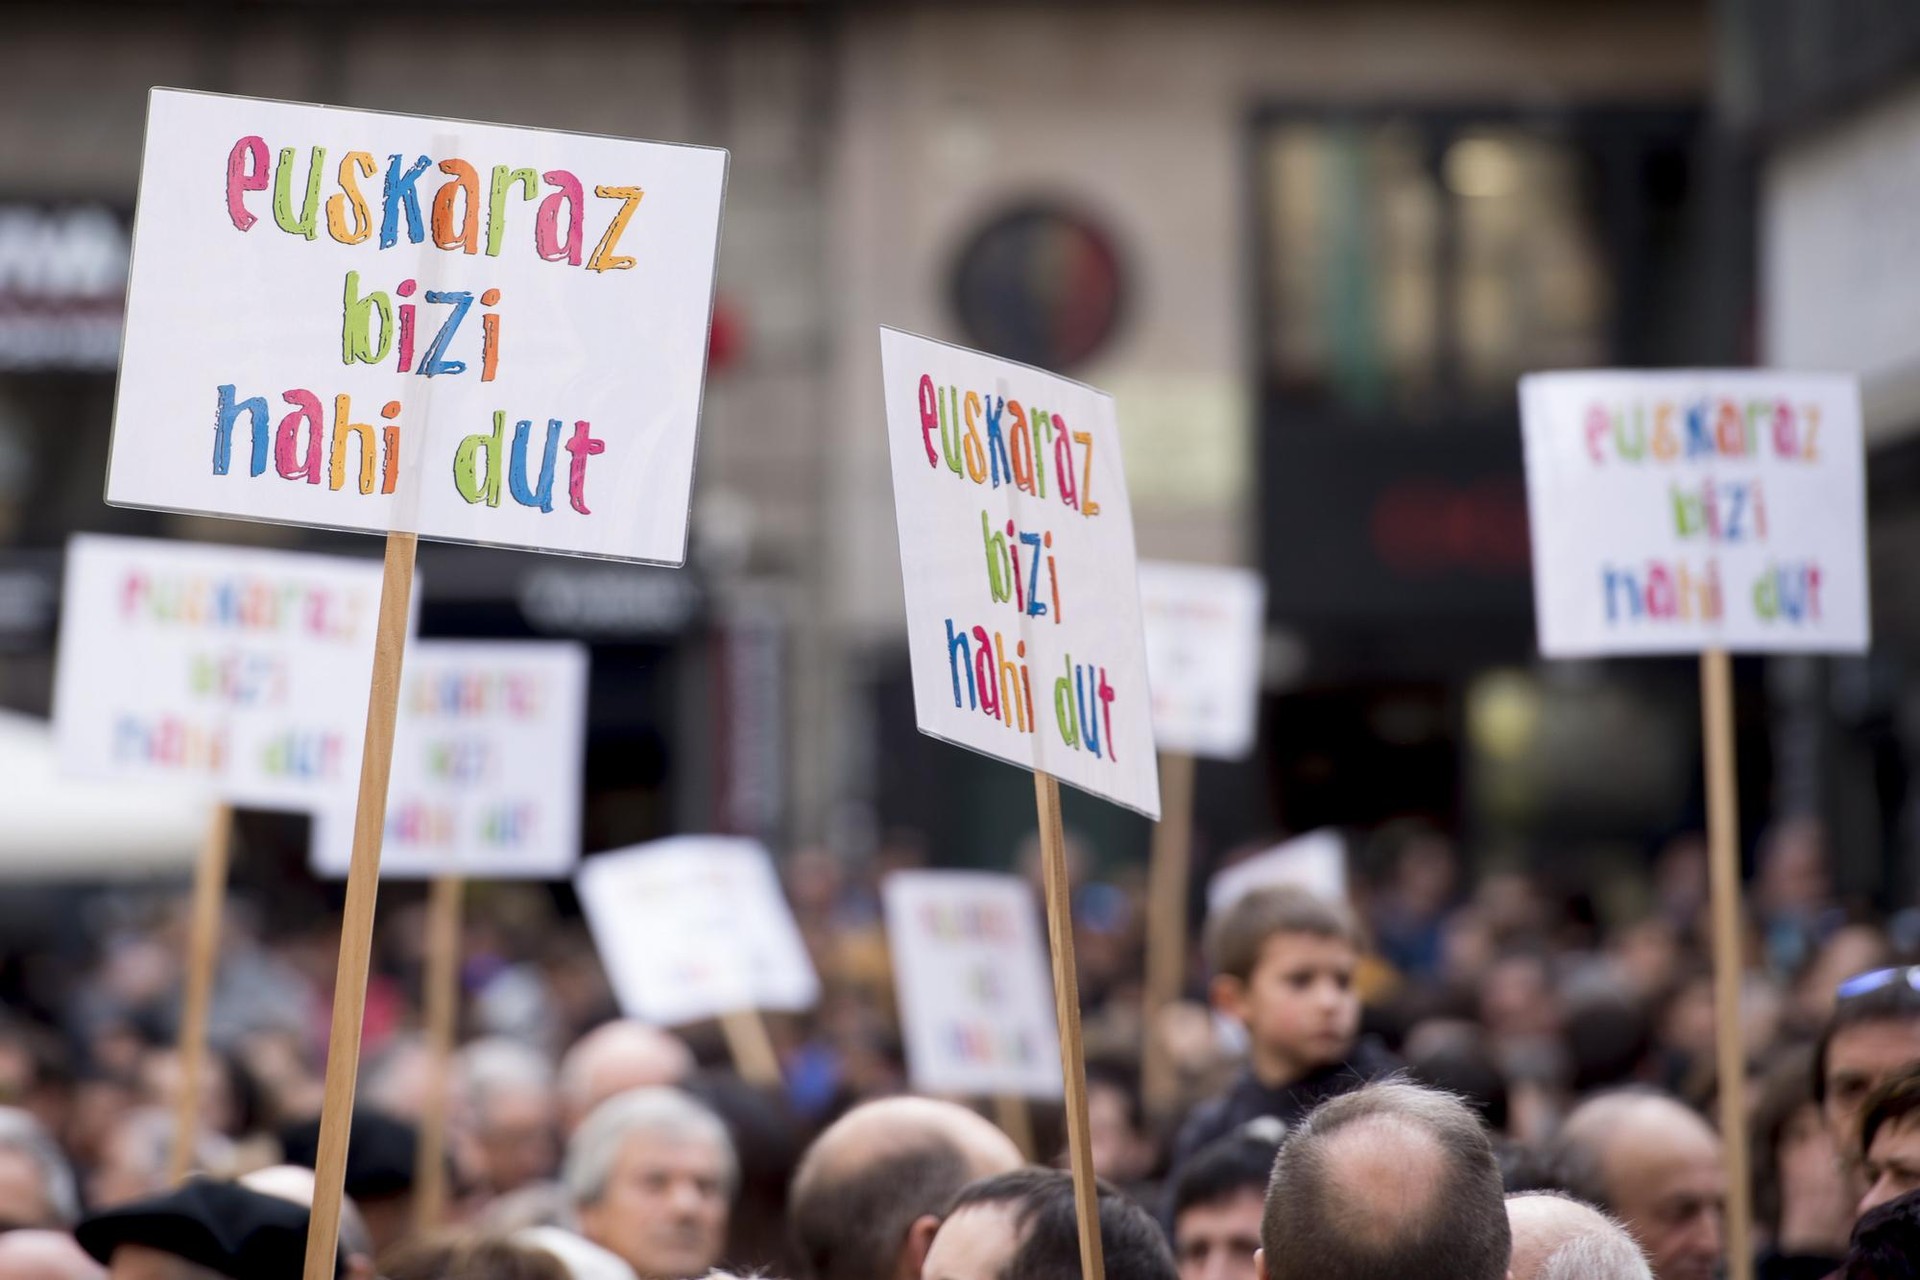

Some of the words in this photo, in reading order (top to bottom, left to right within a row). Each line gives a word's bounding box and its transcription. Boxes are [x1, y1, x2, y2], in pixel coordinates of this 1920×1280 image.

[226, 135, 644, 273] euskaraz
[343, 270, 501, 381] bizi
[213, 384, 401, 495] nahi
[453, 410, 606, 515] dut
[919, 374, 1100, 517] euskaraz
[1585, 396, 1822, 465] euskaraz
[981, 509, 1062, 624] bizi
[1669, 478, 1769, 544] bizi
[1601, 557, 1725, 626] nahi
[1752, 561, 1826, 626] dut
[945, 618, 1035, 733] nahi
[1055, 653, 1117, 762] dut
